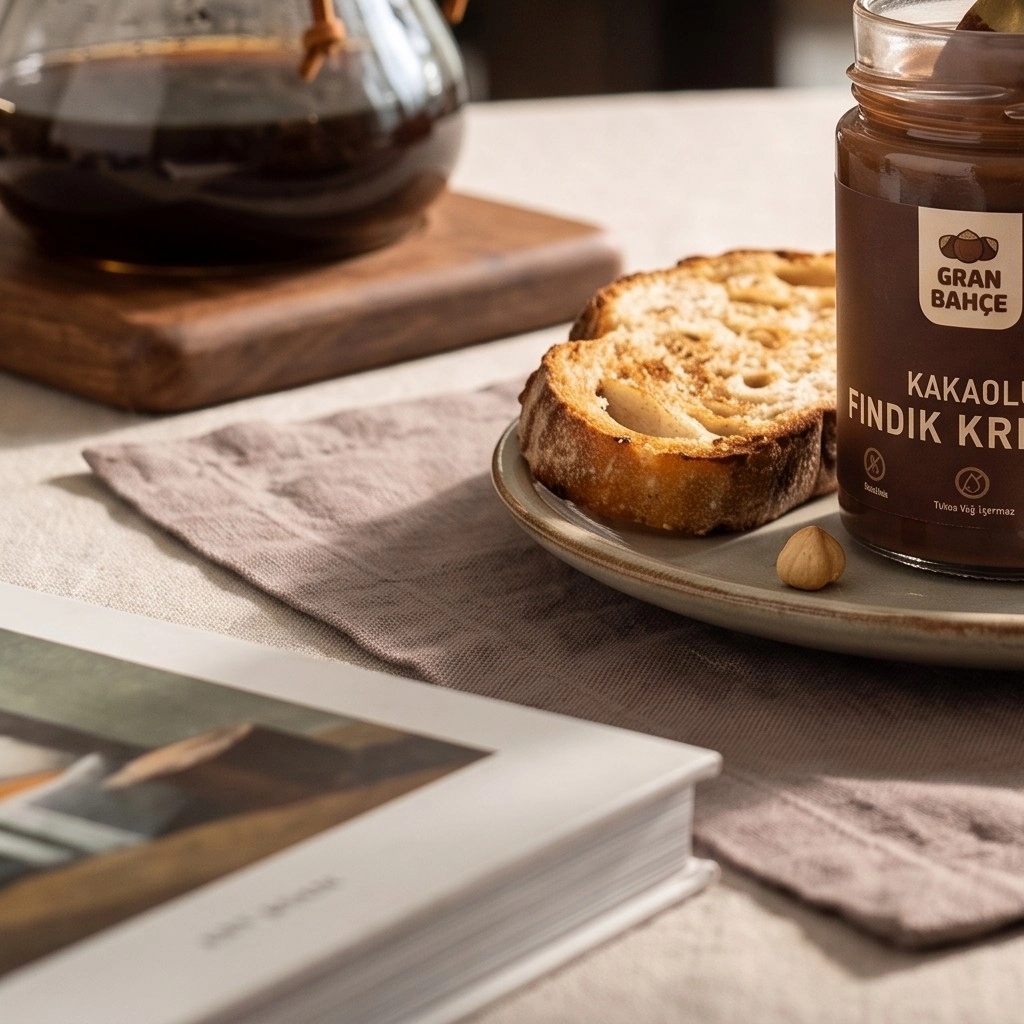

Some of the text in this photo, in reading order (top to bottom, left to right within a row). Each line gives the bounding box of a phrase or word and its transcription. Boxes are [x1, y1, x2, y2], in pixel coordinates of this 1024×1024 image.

[937, 266, 1001, 289] GRAN
[931, 288, 1008, 319] BAHÇE
[848, 386, 942, 444] FINDIK
